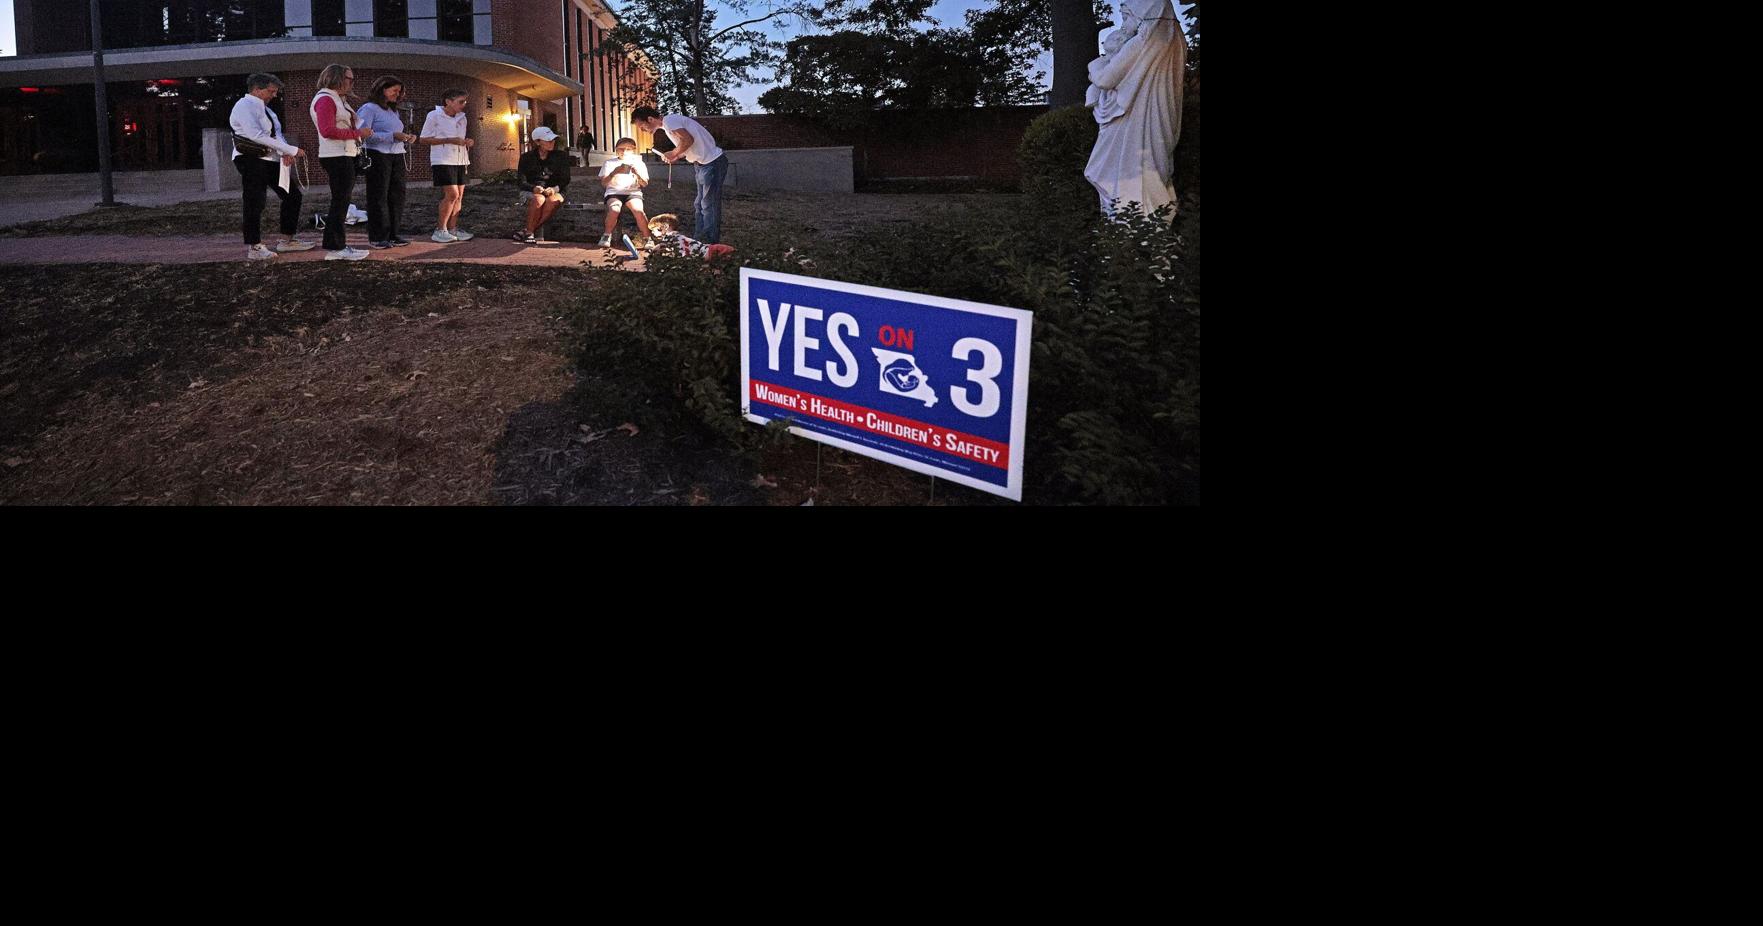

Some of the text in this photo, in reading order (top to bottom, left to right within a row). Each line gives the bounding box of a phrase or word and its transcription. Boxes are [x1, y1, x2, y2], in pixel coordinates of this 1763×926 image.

[756, 298, 1003, 418] YES ON 3
[755, 383, 807, 412] WOMEN'S
[810, 398, 855, 424] HEALTH
[866, 412, 941, 447] CHILDREN'S
[945, 433, 1001, 463] SAFETY
